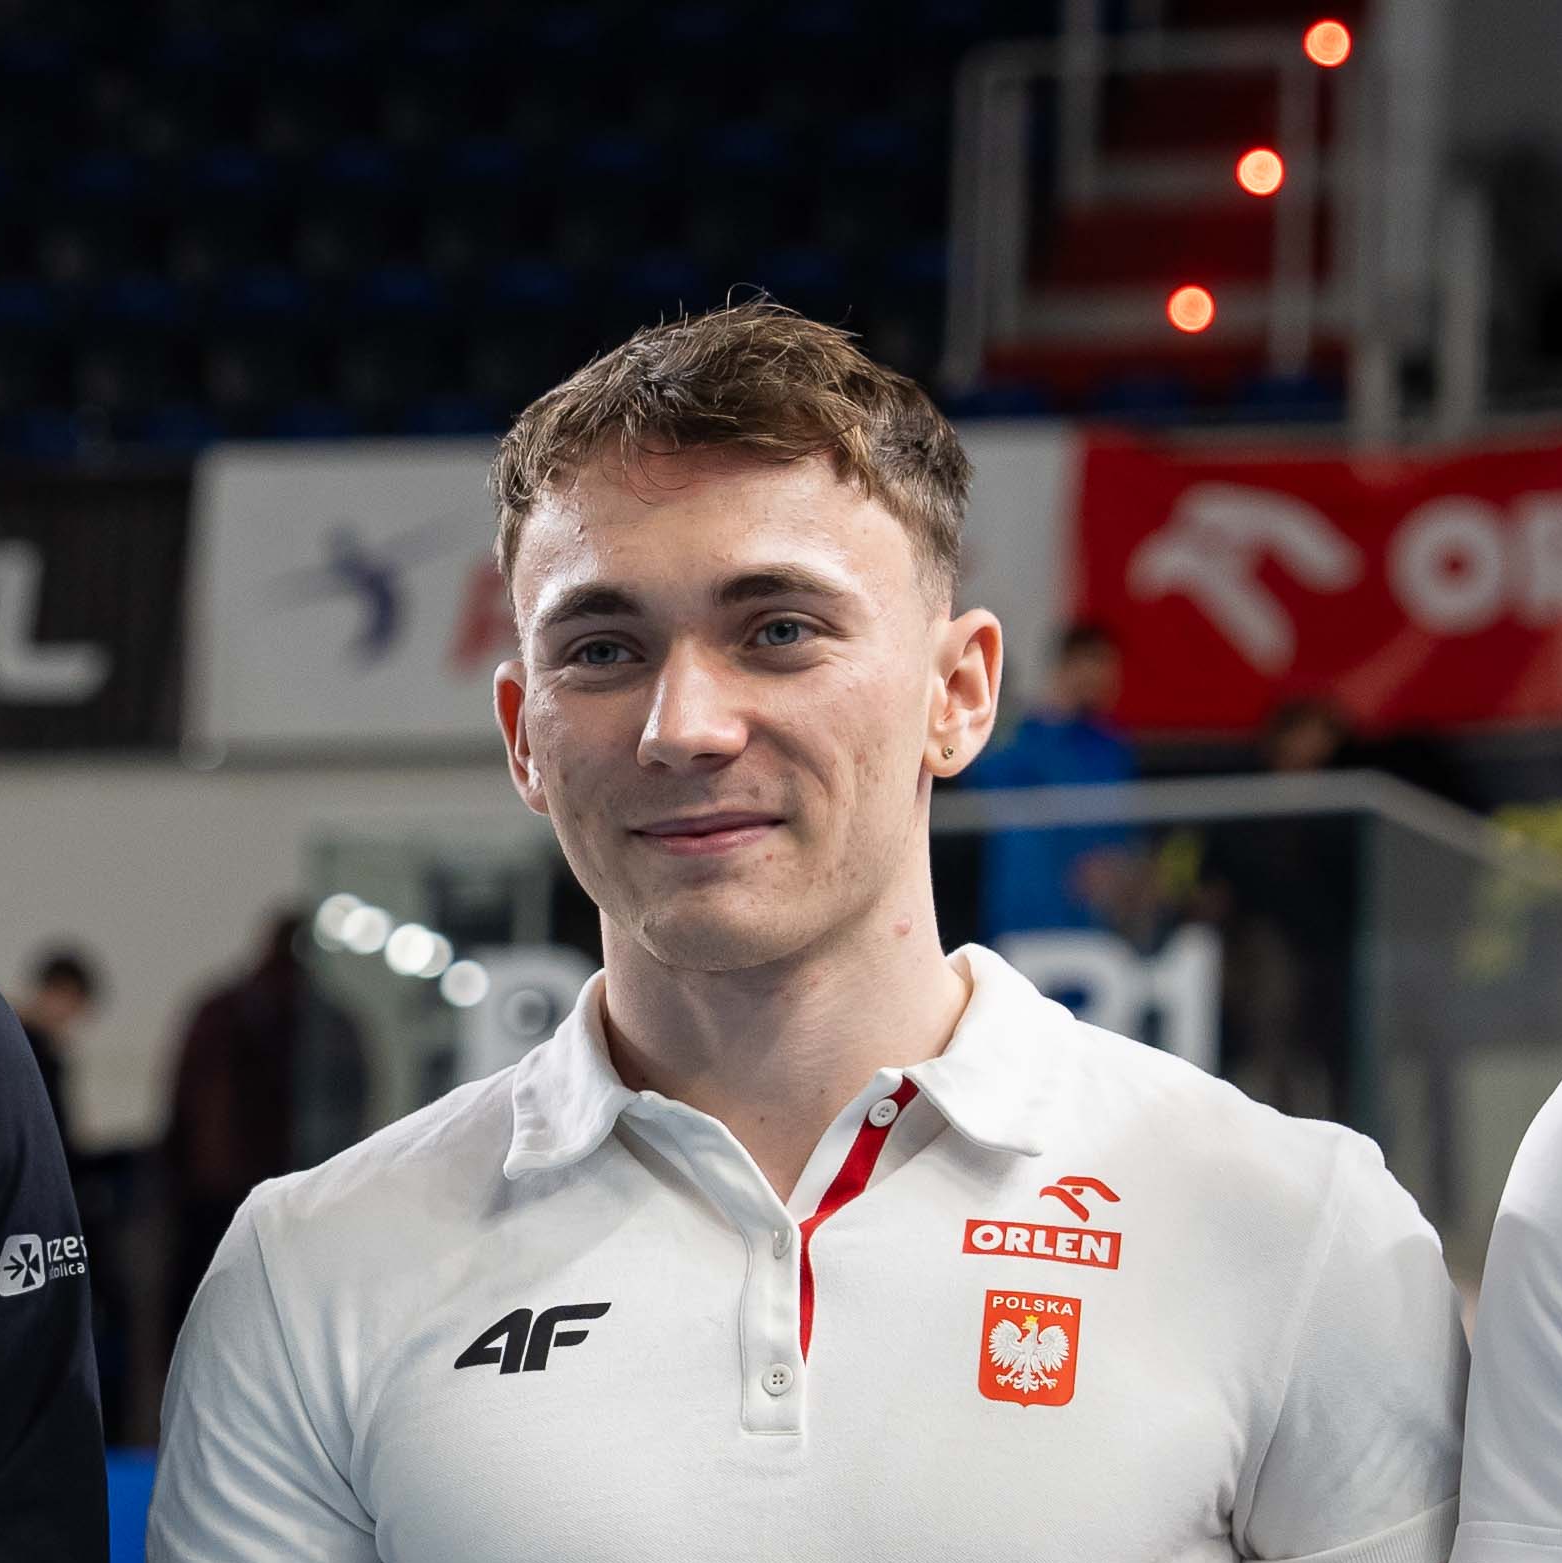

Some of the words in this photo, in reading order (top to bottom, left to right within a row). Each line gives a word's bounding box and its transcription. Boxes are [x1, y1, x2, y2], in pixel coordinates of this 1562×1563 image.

[971, 1224, 1111, 1263] ORLEN
[992, 1296, 1074, 1316] POLSKA
[454, 1302, 612, 1375] 4F
